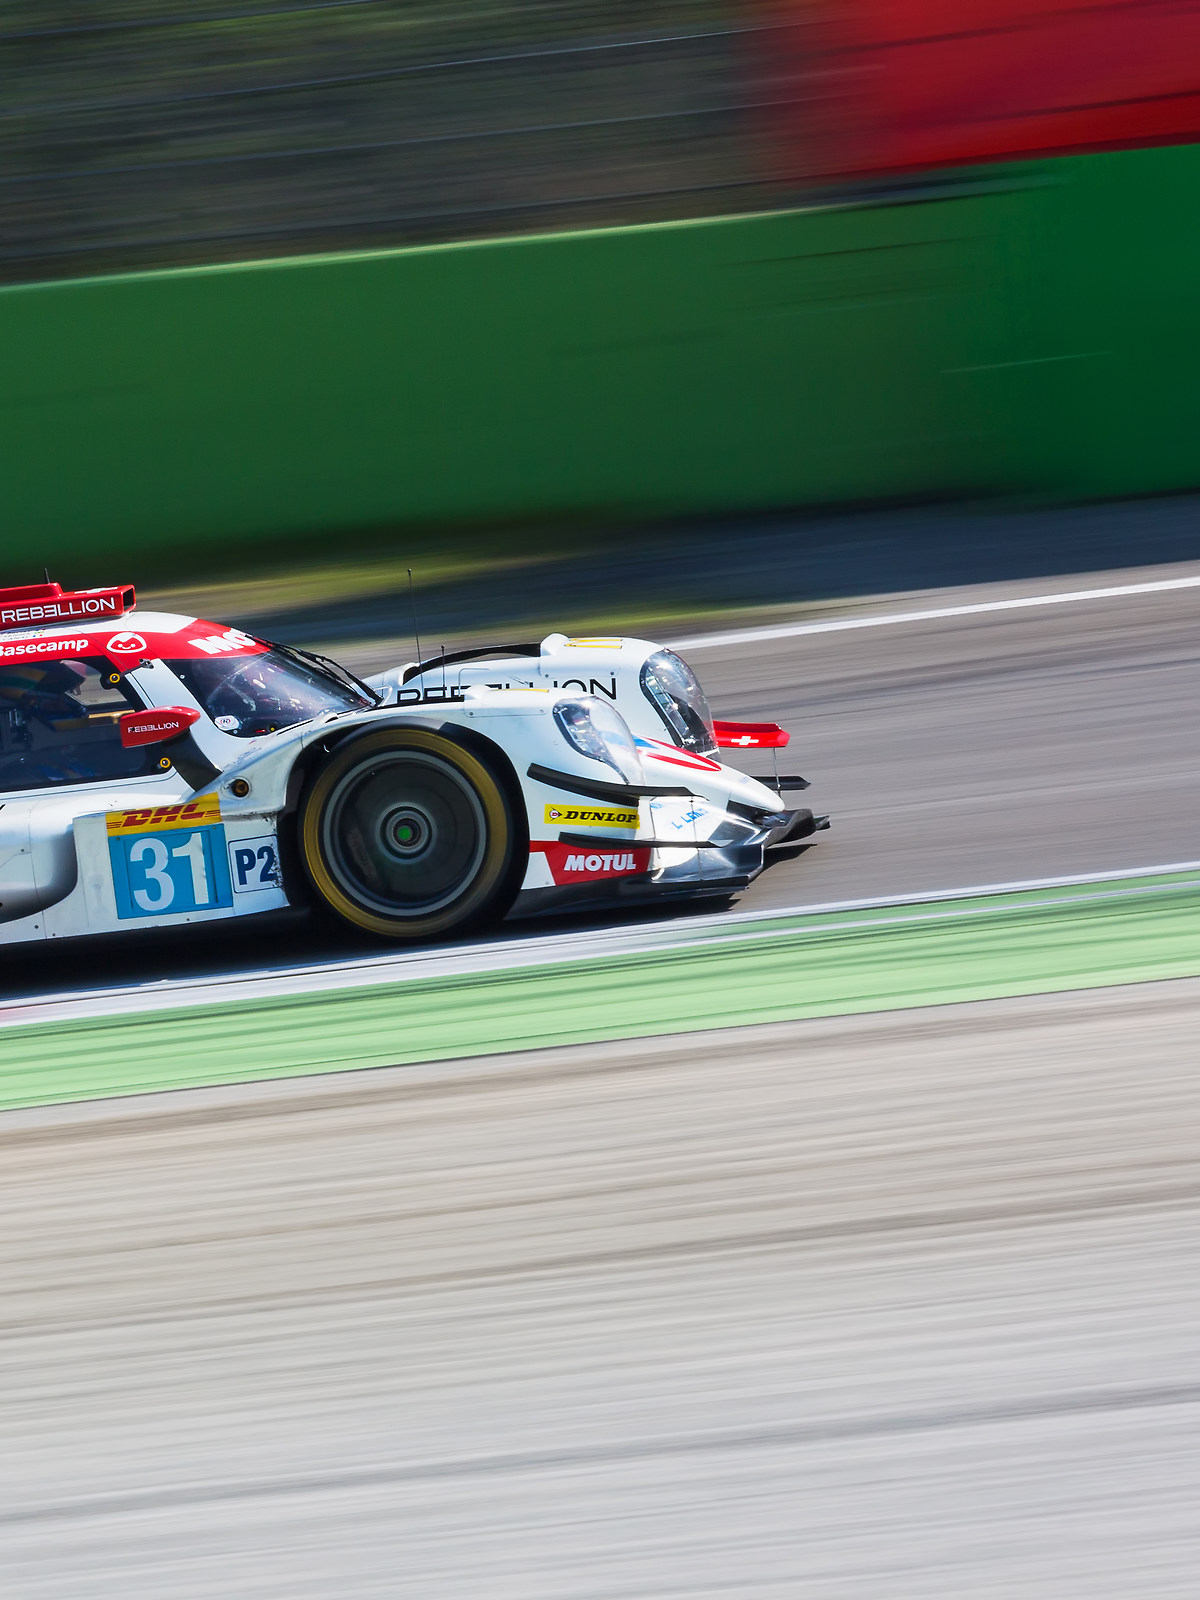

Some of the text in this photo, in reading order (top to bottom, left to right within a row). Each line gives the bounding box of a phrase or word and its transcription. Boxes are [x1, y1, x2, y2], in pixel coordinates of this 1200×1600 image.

[1, 597, 116, 622] REBELLION
[122, 803, 206, 828] DHL
[564, 810, 637, 823] DUNLOP
[129, 832, 210, 911] 31
[235, 845, 279, 885] P2
[564, 853, 637, 872] MOTUL
